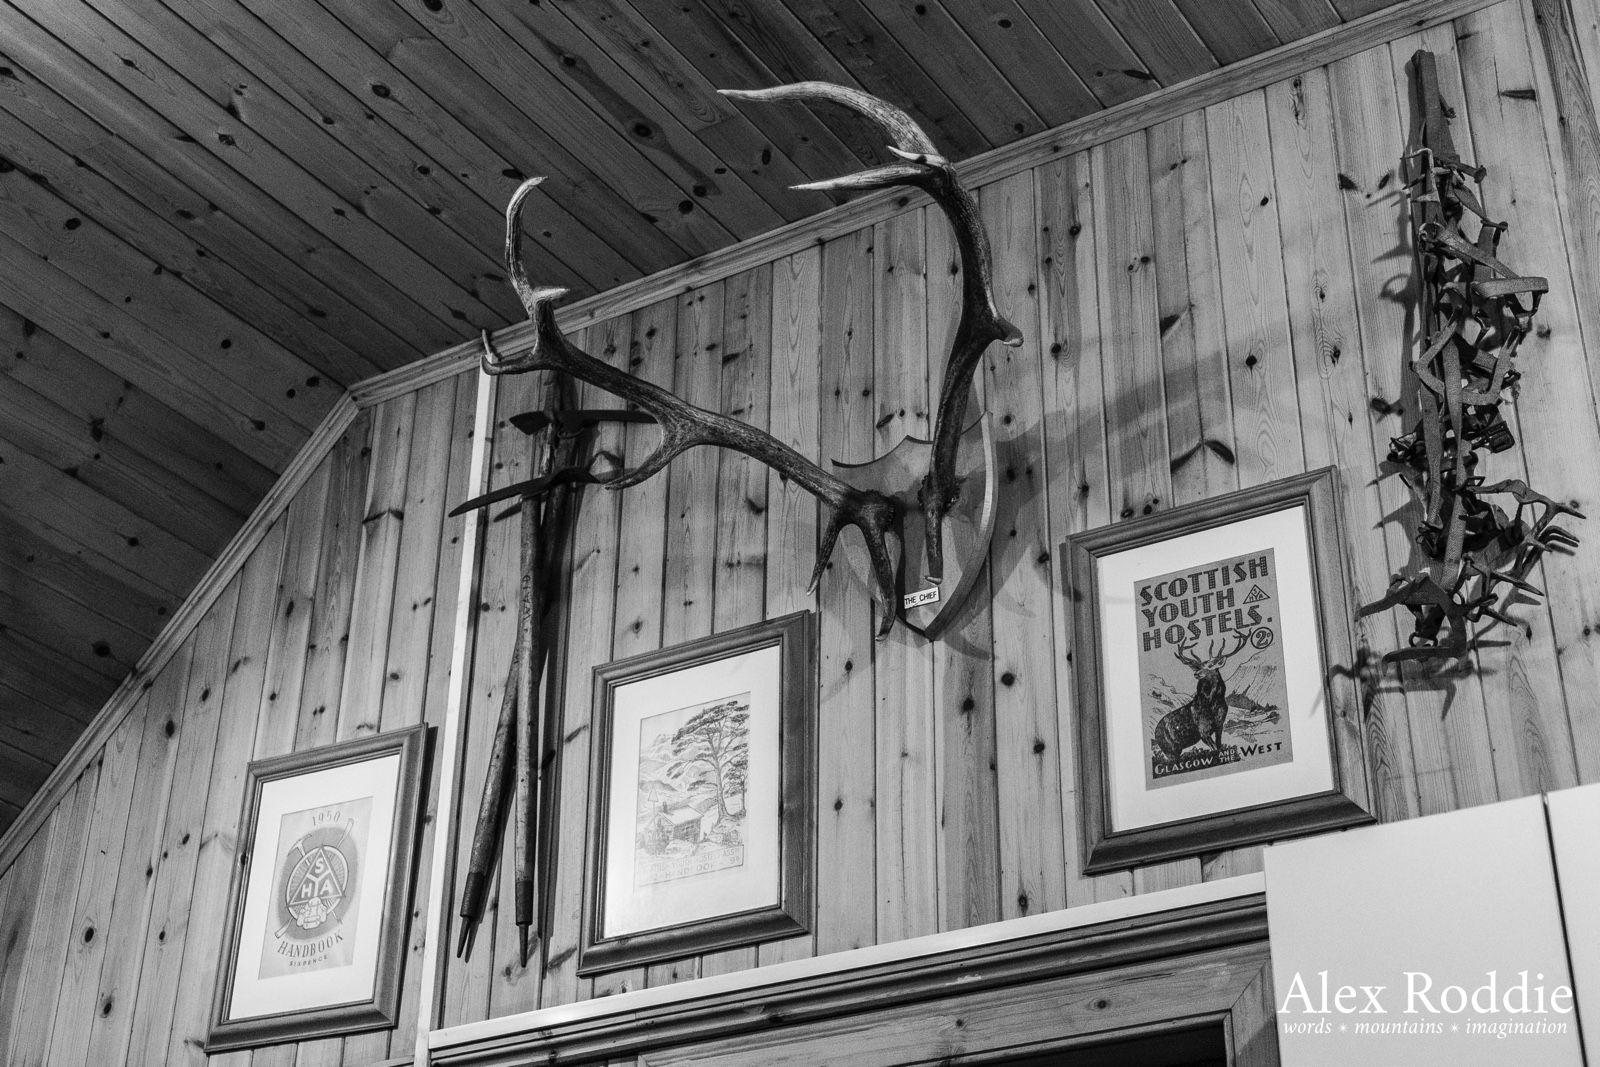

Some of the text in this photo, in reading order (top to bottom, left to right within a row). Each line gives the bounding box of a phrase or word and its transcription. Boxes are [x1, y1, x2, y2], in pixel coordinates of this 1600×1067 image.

[1139, 556, 1269, 607] SCOTTISH
[904, 591, 937, 605] THE CHIEF
[1141, 588, 1236, 628] YOUTH
[1154, 742, 1283, 776] GLASGOW AND THE WEST
[312, 810, 341, 827] 1950
[277, 930, 344, 958] HANDBOOK
[289, 955, 328, 967] SIXPENCE
